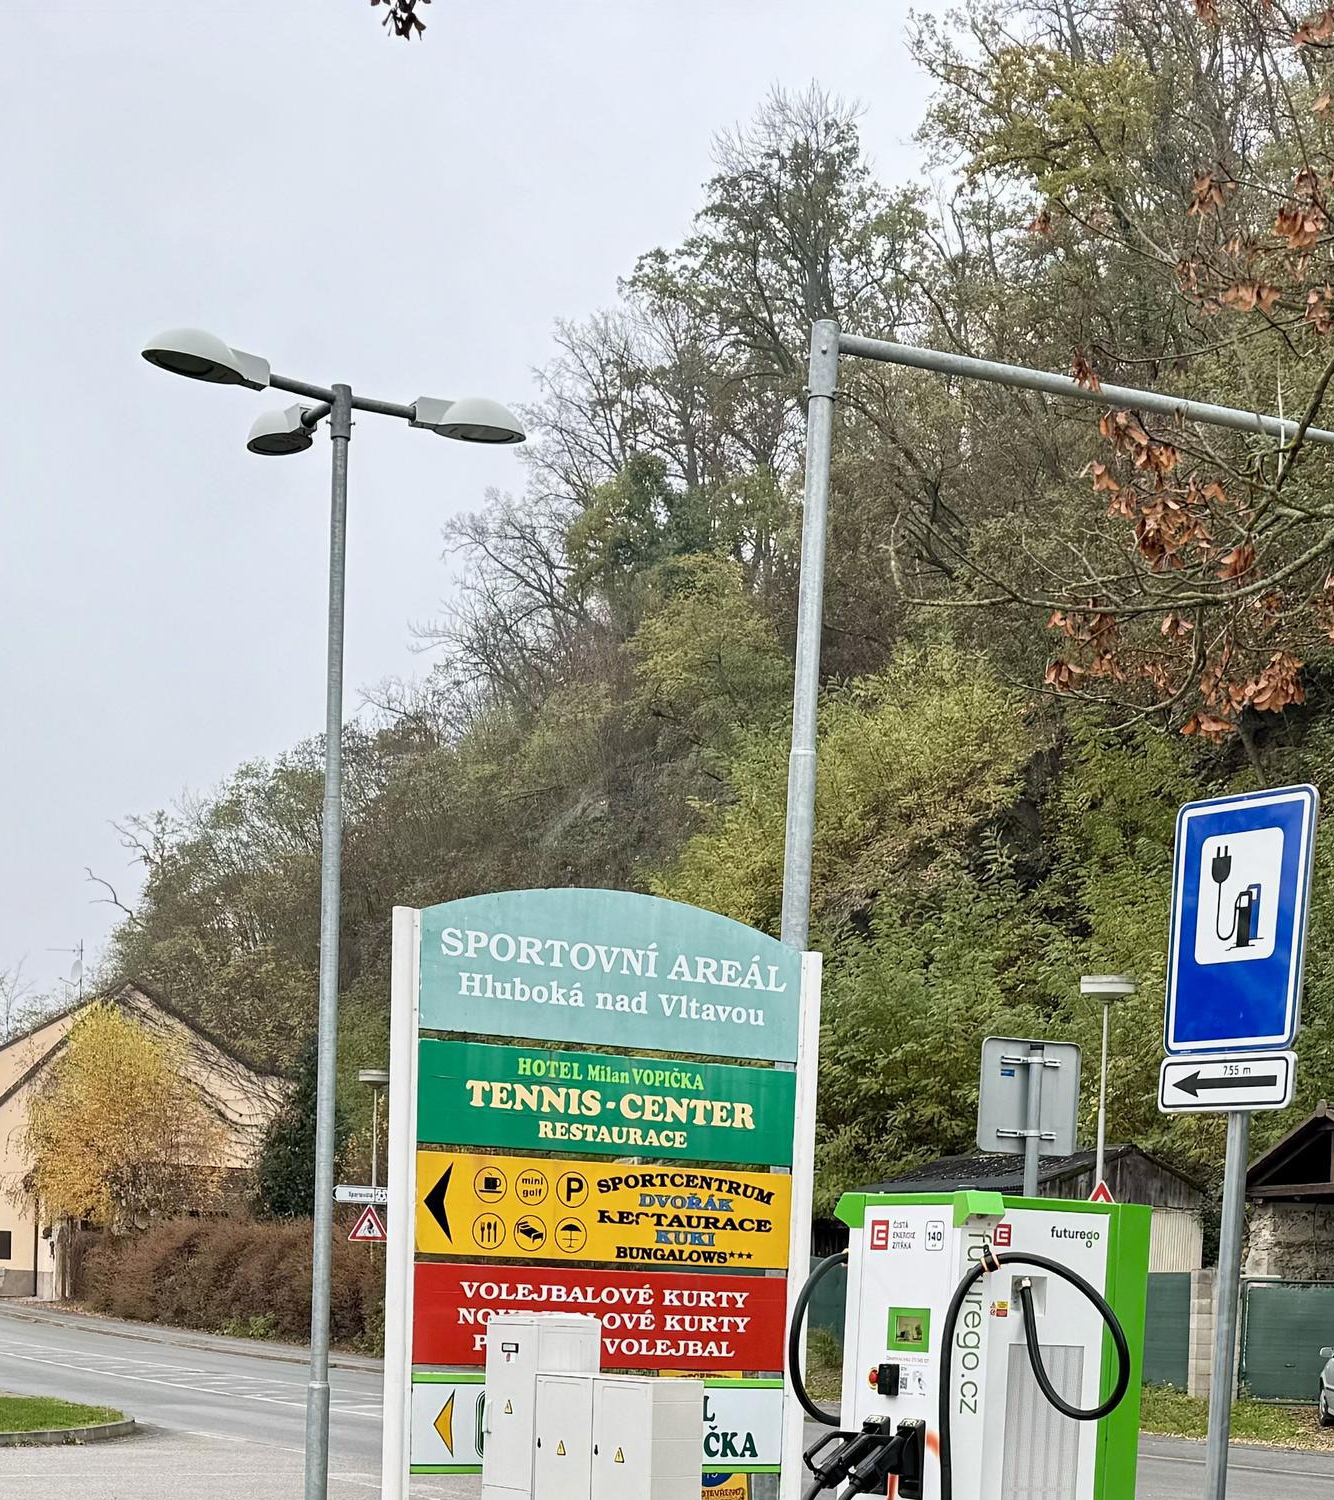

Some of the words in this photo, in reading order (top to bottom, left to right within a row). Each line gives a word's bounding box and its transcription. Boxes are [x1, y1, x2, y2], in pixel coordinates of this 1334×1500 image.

[441, 927, 659, 978] SPORTOVNÍ
[667, 954, 787, 993] AREÁL
[458, 972, 585, 1007] Hluboká
[595, 991, 648, 1015] nad
[658, 993, 765, 1026] Vltavou
[517, 1057, 583, 1080] HOTEL
[587, 1064, 630, 1084] Milan
[632, 1067, 704, 1090] VOPIČKA
[538, 1121, 688, 1148] RESTAURACE
[522, 1177, 543, 1185] mini
[522, 1188, 542, 1197] golf
[566, 1177, 584, 1202] P
[597, 1173, 775, 1205] SPORTCENTRUM
[638, 1193, 734, 1212] DVOŘÁK
[655, 1230, 716, 1246] KUKI
[928, 1231, 942, 1241] 140
[460, 1282, 654, 1305] VOLEJBALOVÉ
[662, 1289, 749, 1308] KURTY
[664, 1314, 751, 1333] KURTY
[956, 1231, 992, 1414] fuurego.cz
[602, 1338, 735, 1357] VOLEJBAL
